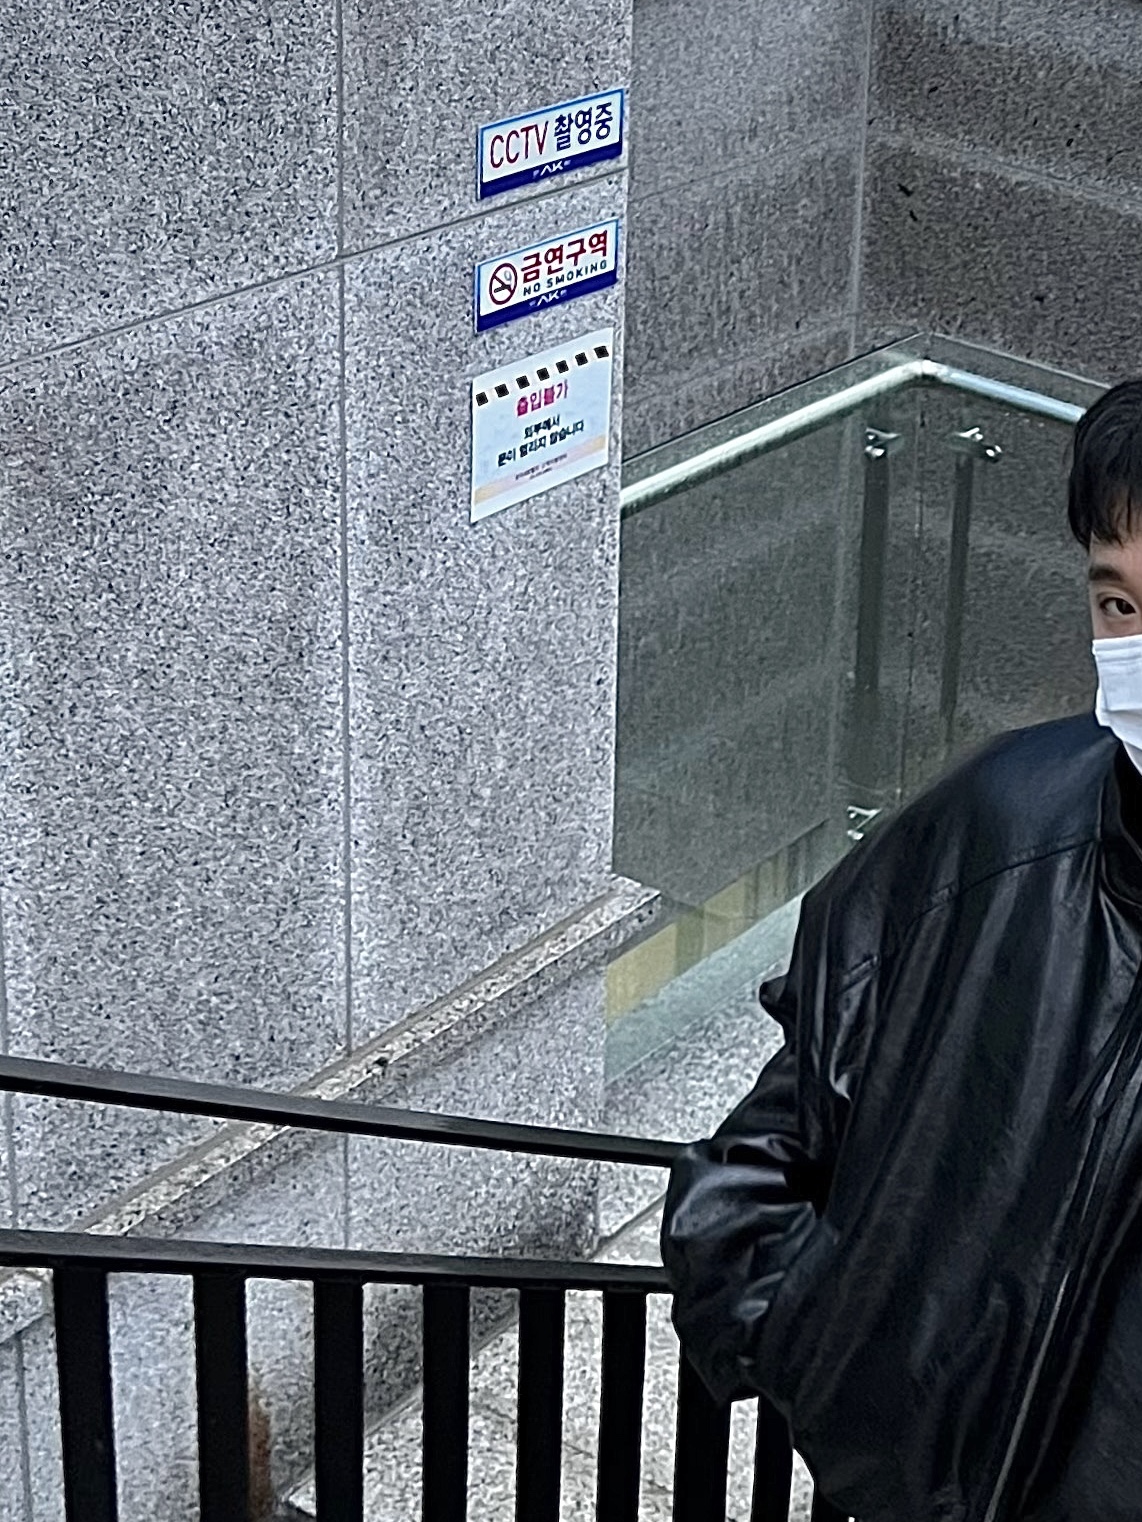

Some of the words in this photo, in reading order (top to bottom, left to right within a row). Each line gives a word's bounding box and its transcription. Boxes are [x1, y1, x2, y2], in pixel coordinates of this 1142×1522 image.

[489, 121, 549, 169] CCTV
[554, 102, 613, 152] 촬영중
[520, 230, 608, 284] 금연구역
[523, 282, 541, 297] NO
[546, 260, 608, 289] SMOKING
[516, 379, 569, 417] 출입불가
